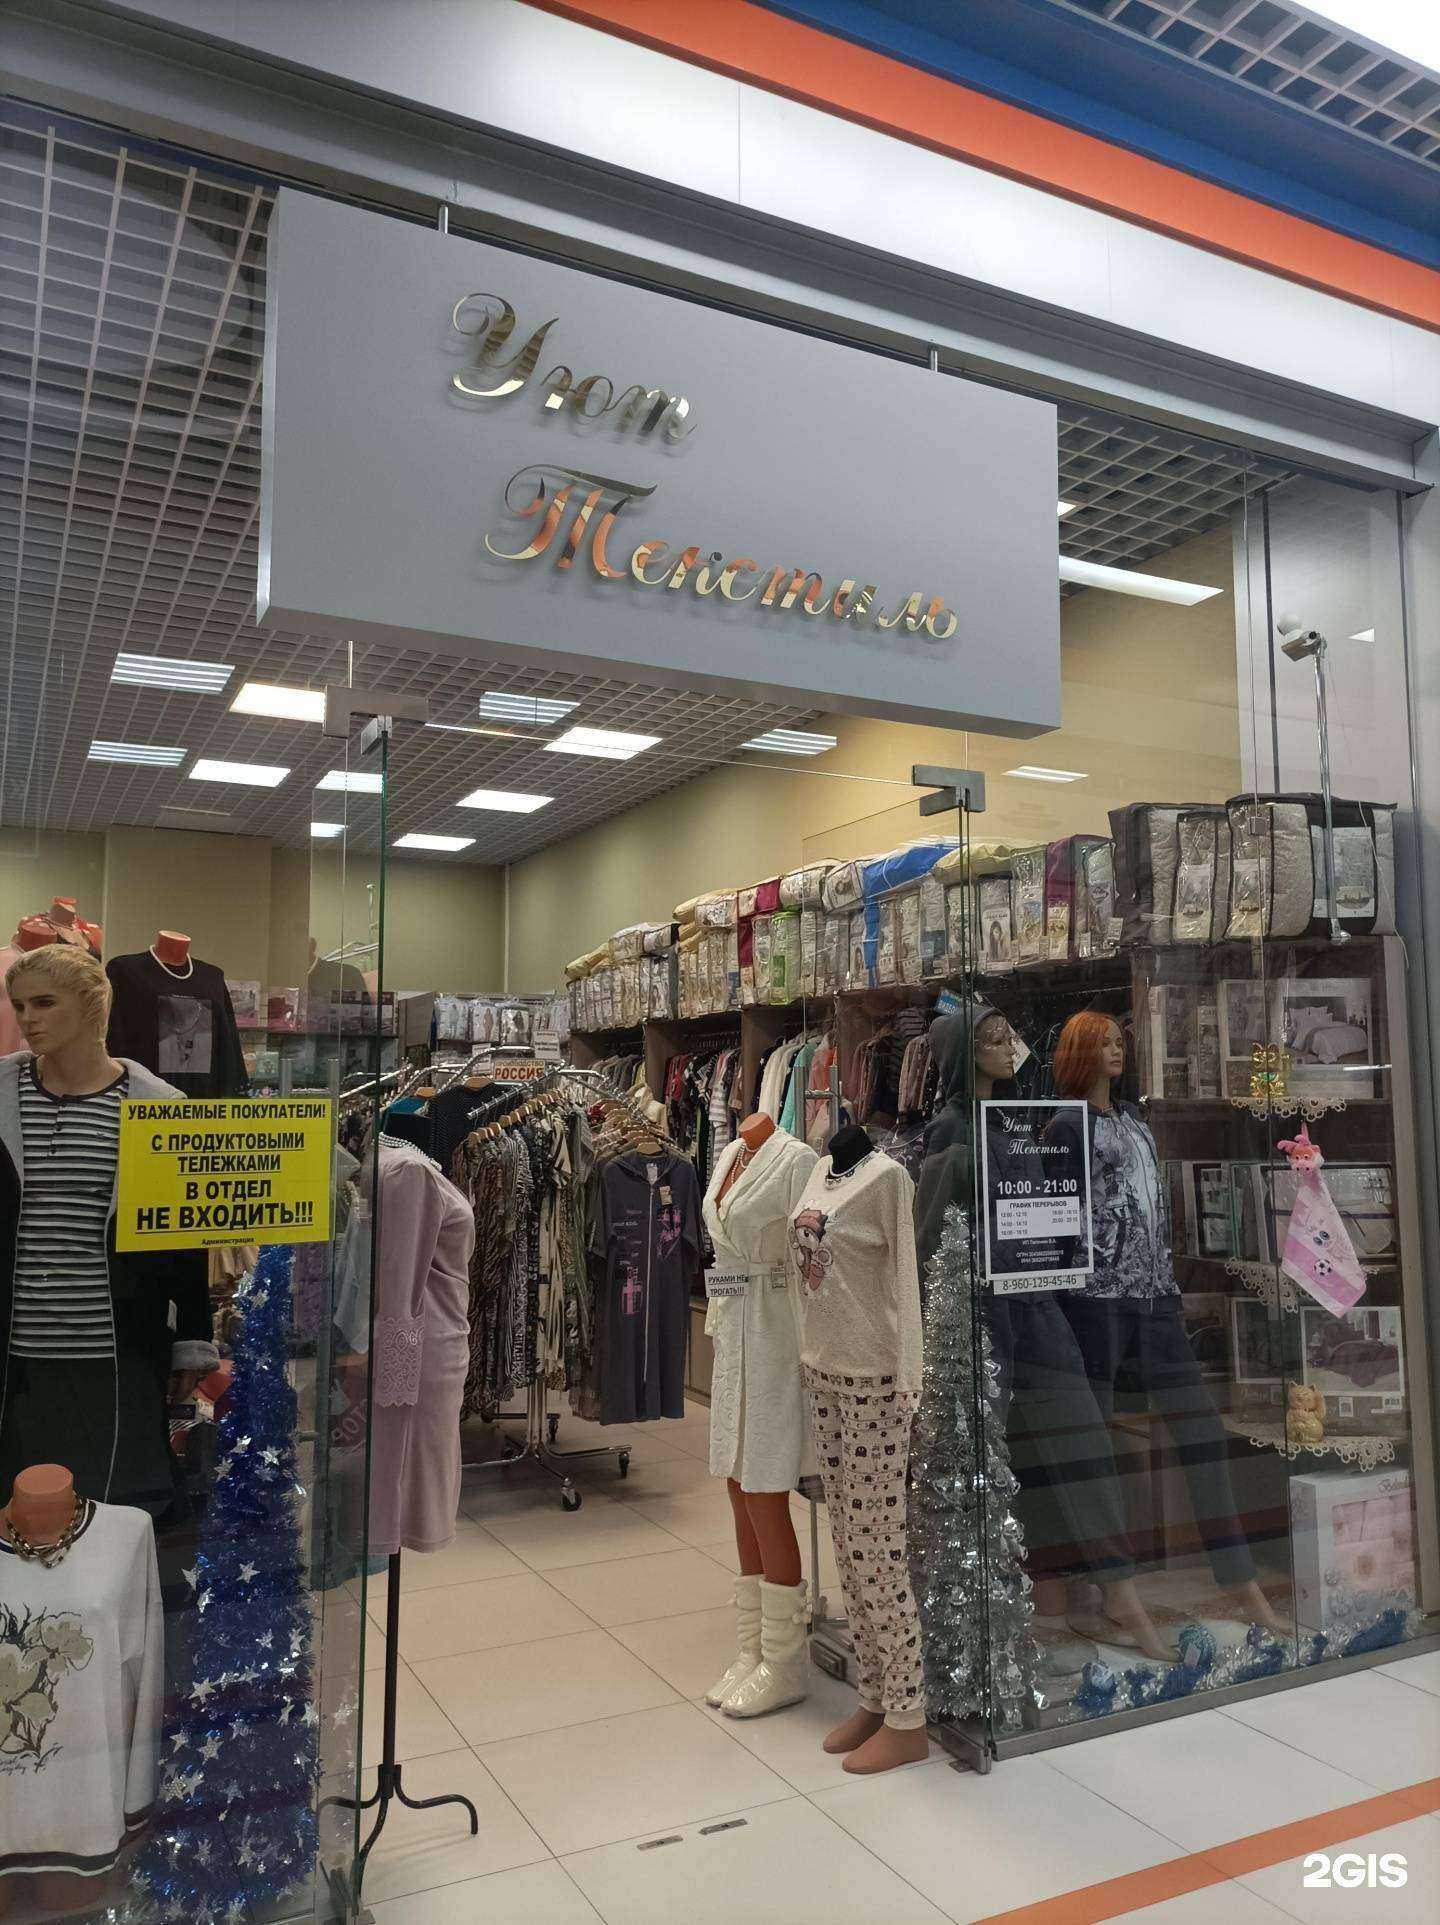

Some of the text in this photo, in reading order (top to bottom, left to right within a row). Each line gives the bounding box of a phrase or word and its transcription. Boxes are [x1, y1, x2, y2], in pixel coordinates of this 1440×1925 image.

[452, 293, 697, 440] Уют
[484, 464, 957, 638] Текстиль
[495, 1067, 545, 1080] РОССИЯ
[128, 1104, 326, 1120] УВАЖАЕМЫЕ ПОКУПАТЕЛИ!
[1002, 1116, 1032, 1133] Уют
[151, 1132, 305, 1152] С ПРОДУКТОВЫМИ
[1007, 1138, 1070, 1155] Текстиль
[177, 1155, 281, 1173] ТЕЛЕЖКАМИ
[186, 1180, 271, 1201] В ОТДЕЛ
[997, 1181, 1032, 1195] 10:00
[1043, 1179, 1077, 1193] 21:00
[137, 1201, 313, 1230] НЕ ВХОДИТЬ!!!
[201, 1236, 255, 1246] Администрация
[1003, 1274, 1077, 1290] 8-960-129-45-46
